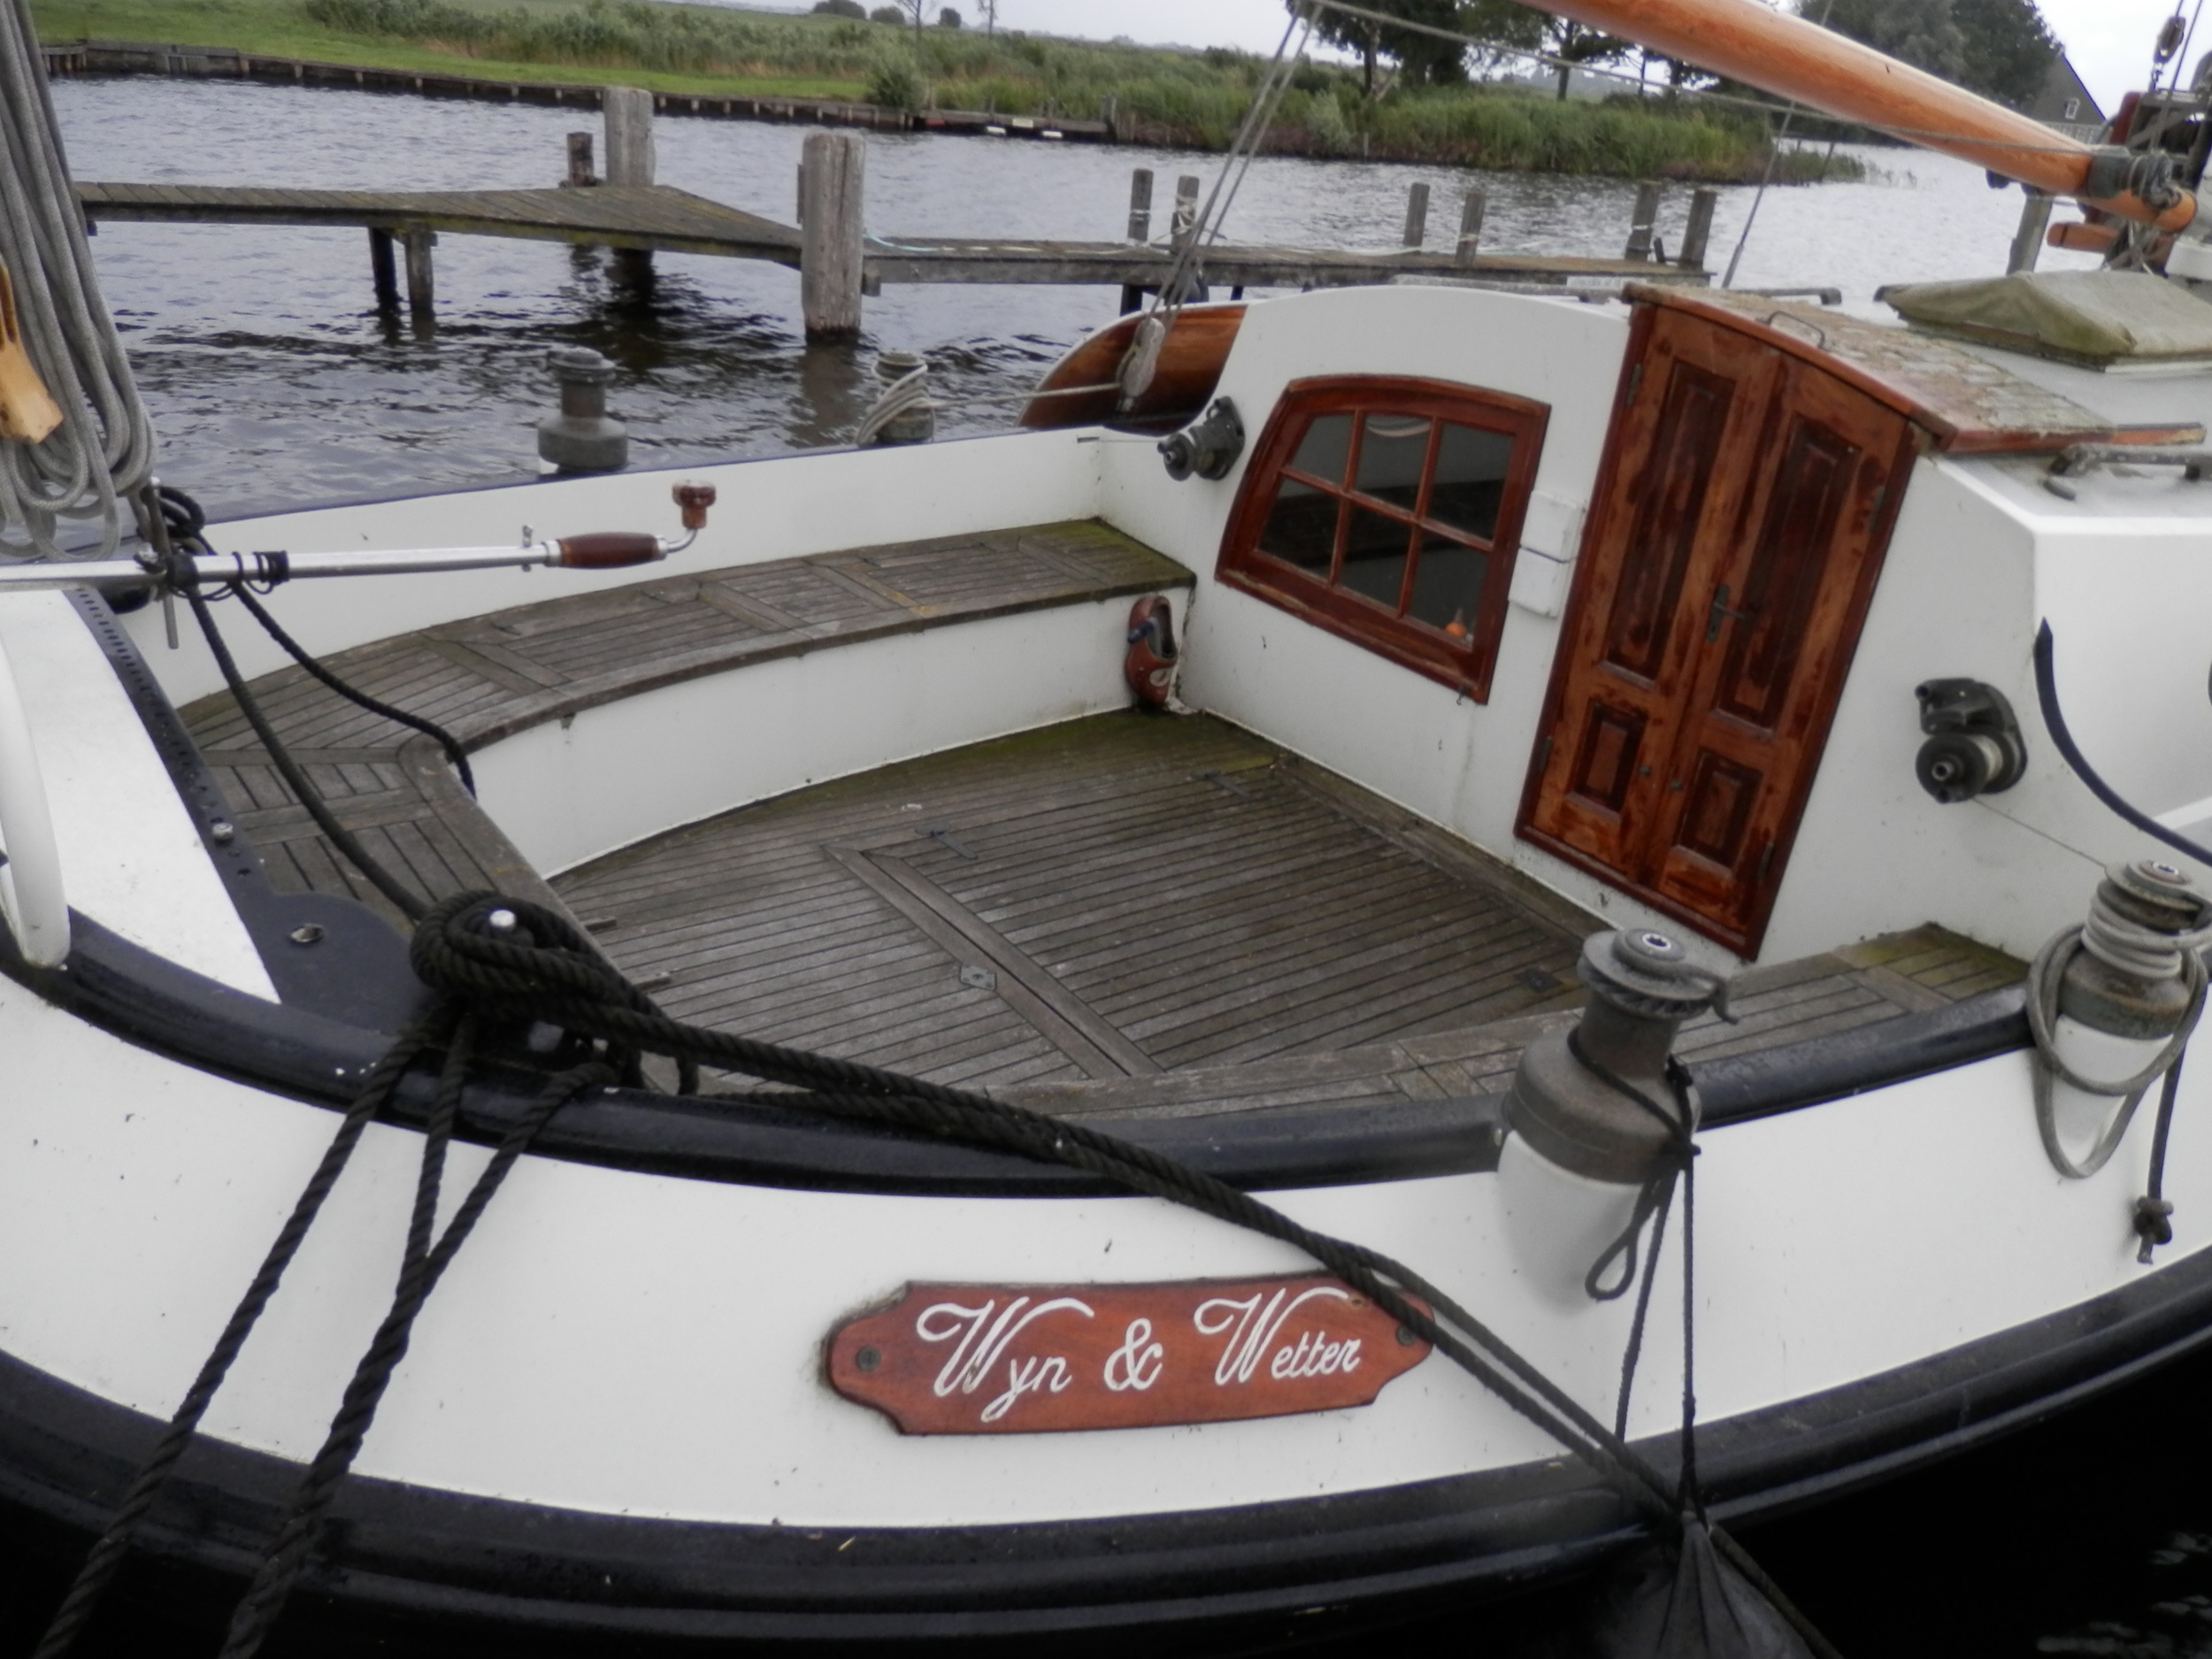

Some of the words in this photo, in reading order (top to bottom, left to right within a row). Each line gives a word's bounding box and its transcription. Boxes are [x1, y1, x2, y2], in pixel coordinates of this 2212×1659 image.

[917, 1296, 1095, 1423] Wyn
[1103, 1318, 1163, 1392] &
[1194, 1286, 1361, 1386] Wetter
